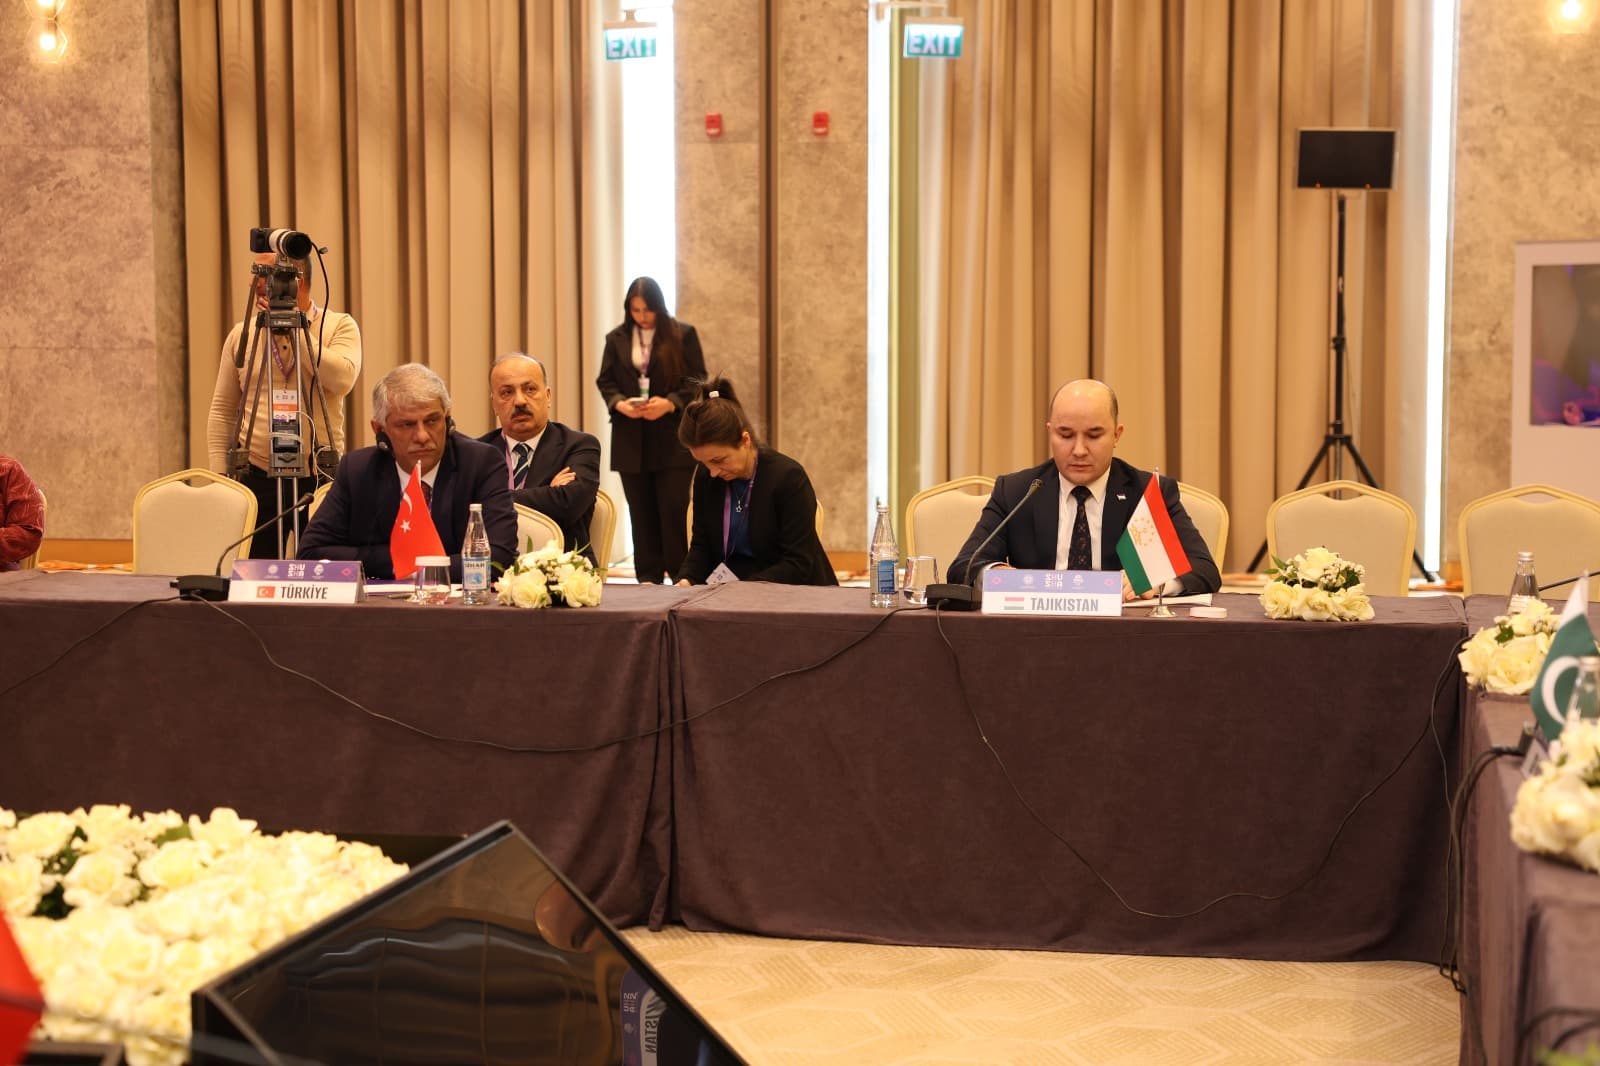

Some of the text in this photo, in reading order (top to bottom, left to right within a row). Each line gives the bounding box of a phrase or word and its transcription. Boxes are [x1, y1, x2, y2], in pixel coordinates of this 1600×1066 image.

[607, 33, 656, 58] EXIT
[909, 32, 959, 55] EXIT
[280, 584, 328, 600] TÜRKİYE
[1030, 597, 1099, 612] TAJIKISTAN
